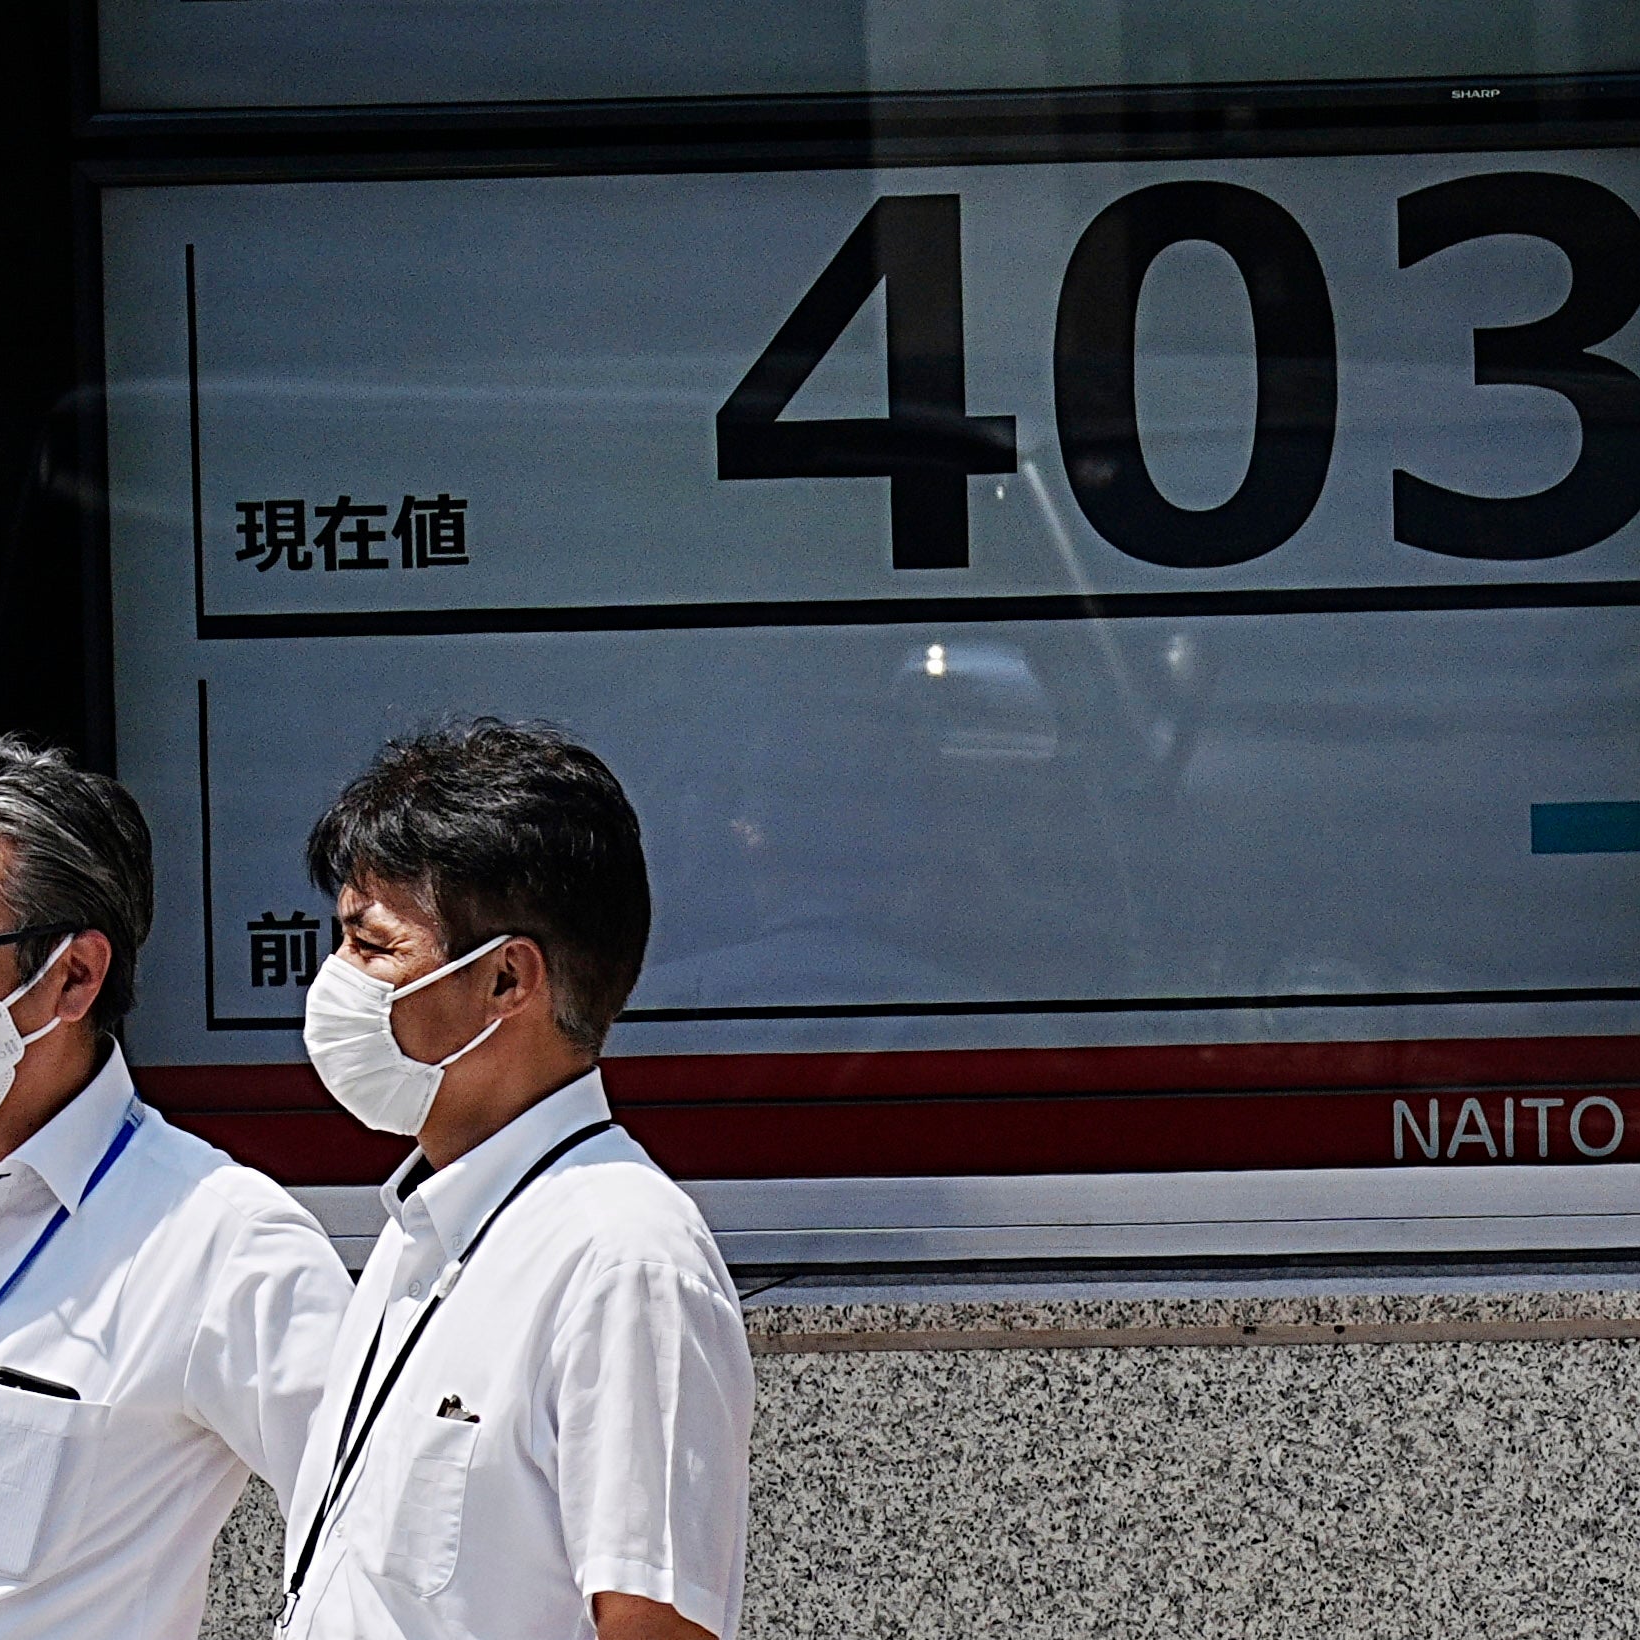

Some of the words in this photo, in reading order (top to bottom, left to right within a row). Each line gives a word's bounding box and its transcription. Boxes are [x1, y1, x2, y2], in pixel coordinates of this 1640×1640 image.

[1451, 89, 1501, 99] SHARP
[234, 494, 470, 573] 現在値
[1392, 1096, 1625, 1160] NAITO
